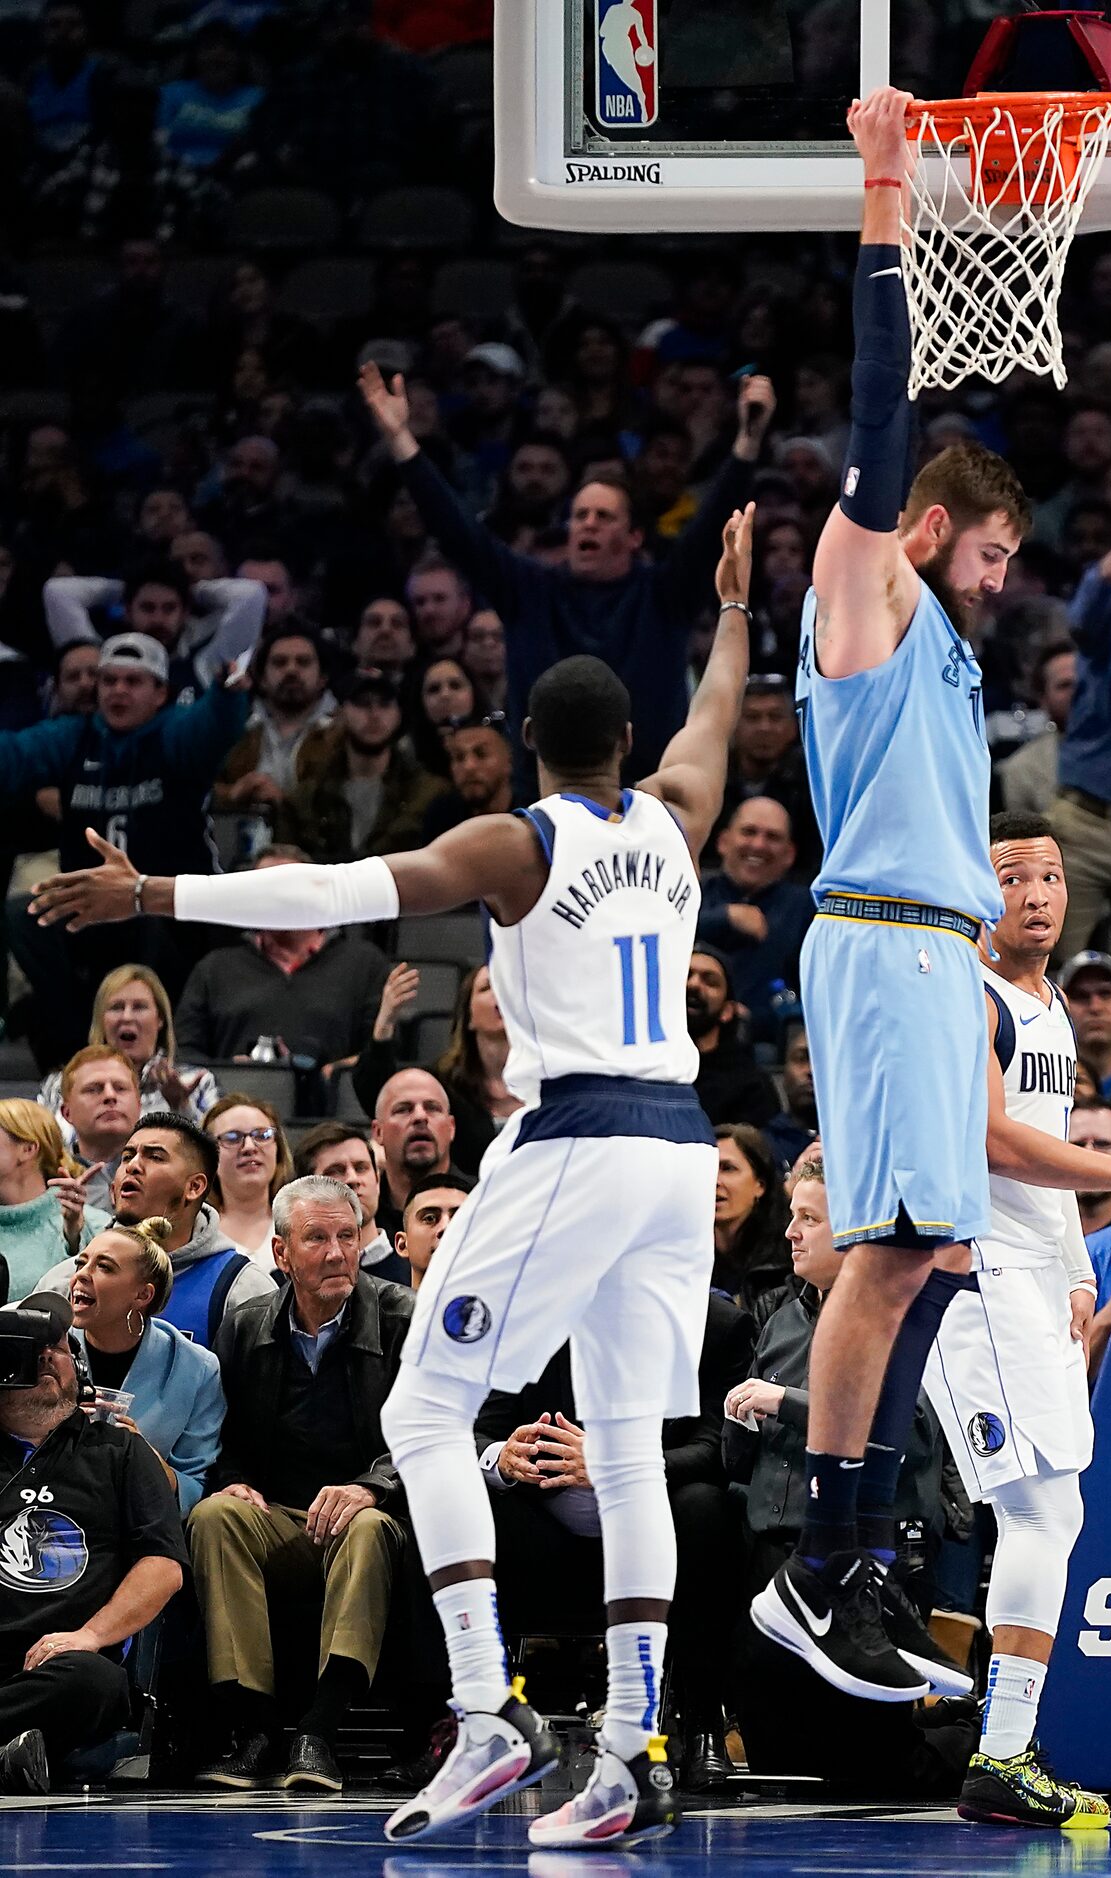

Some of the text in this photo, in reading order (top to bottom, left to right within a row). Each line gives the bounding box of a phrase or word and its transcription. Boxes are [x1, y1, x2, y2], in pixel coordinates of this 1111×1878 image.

[605, 94, 635, 118] NBA
[565, 162, 662, 185] SPALDING
[551, 849, 666, 930] HARDAWAY
[613, 933, 667, 1045] 11
[20, 1485, 54, 1505] 96
